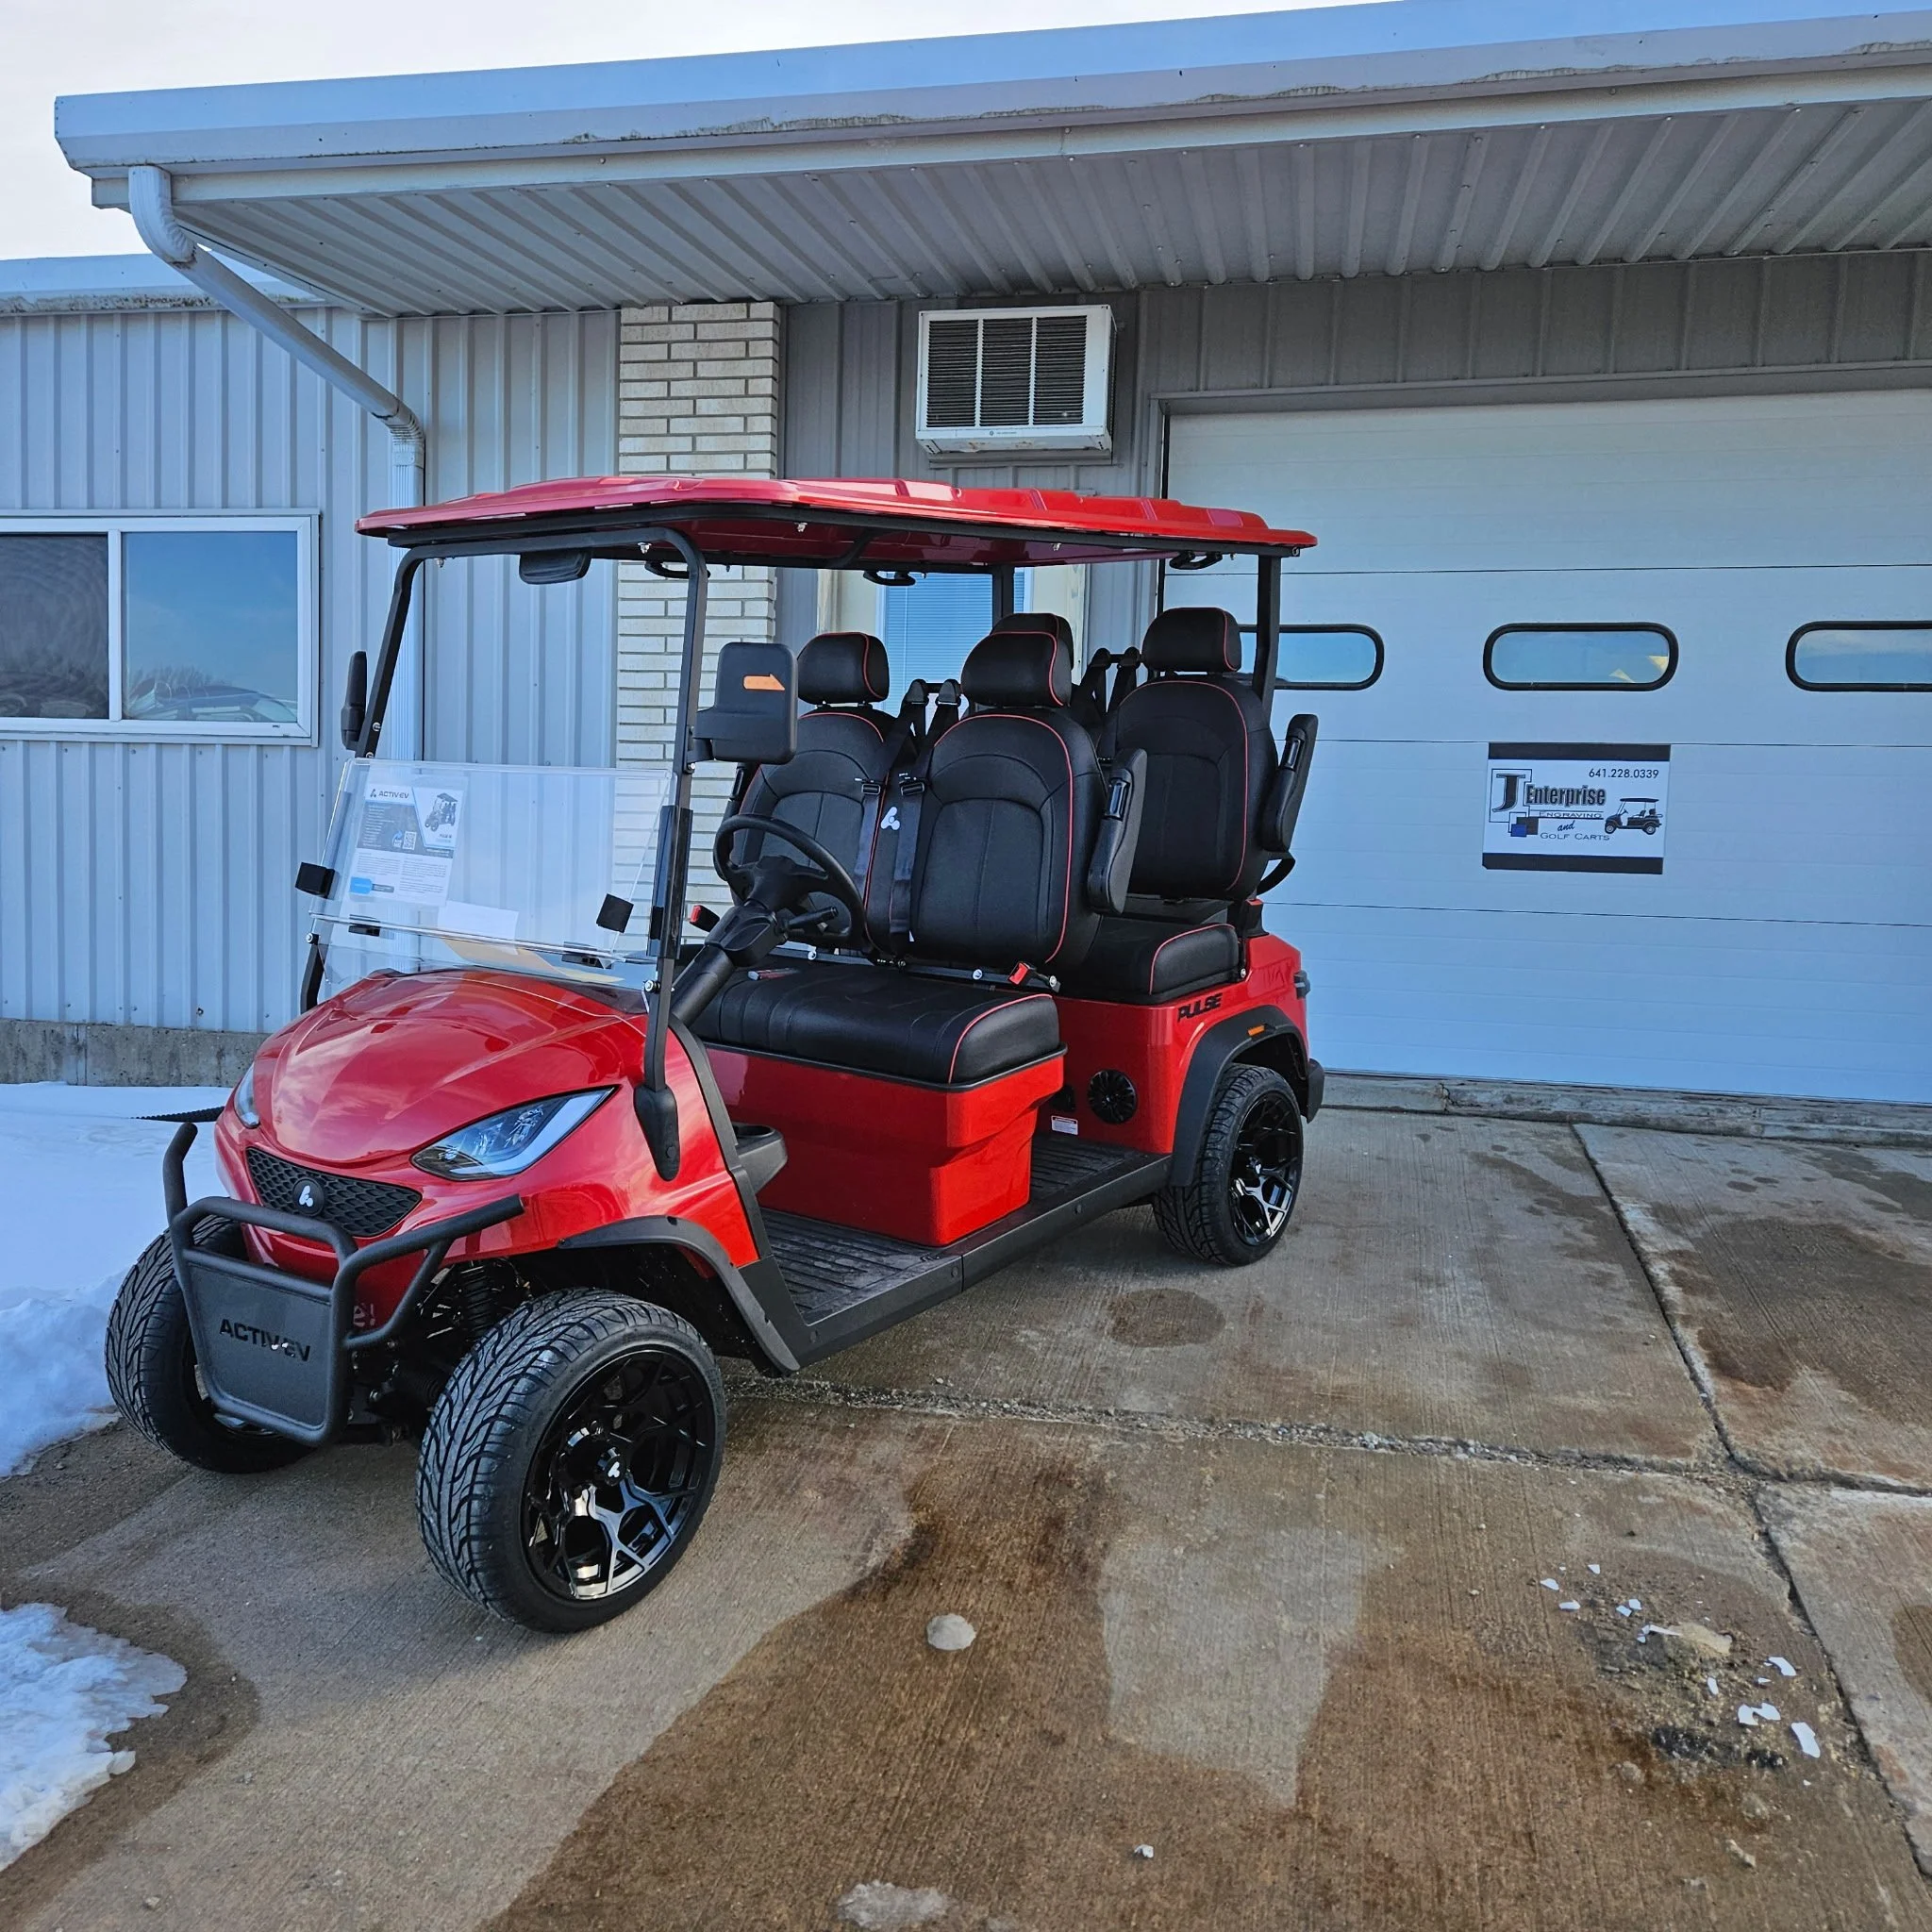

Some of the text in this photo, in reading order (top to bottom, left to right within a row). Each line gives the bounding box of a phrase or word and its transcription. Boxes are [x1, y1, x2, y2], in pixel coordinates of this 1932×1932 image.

[1589, 768, 1659, 779] 641.228.0339
[1492, 774, 1606, 812] J Enterprise
[1557, 820, 1575, 832] and
